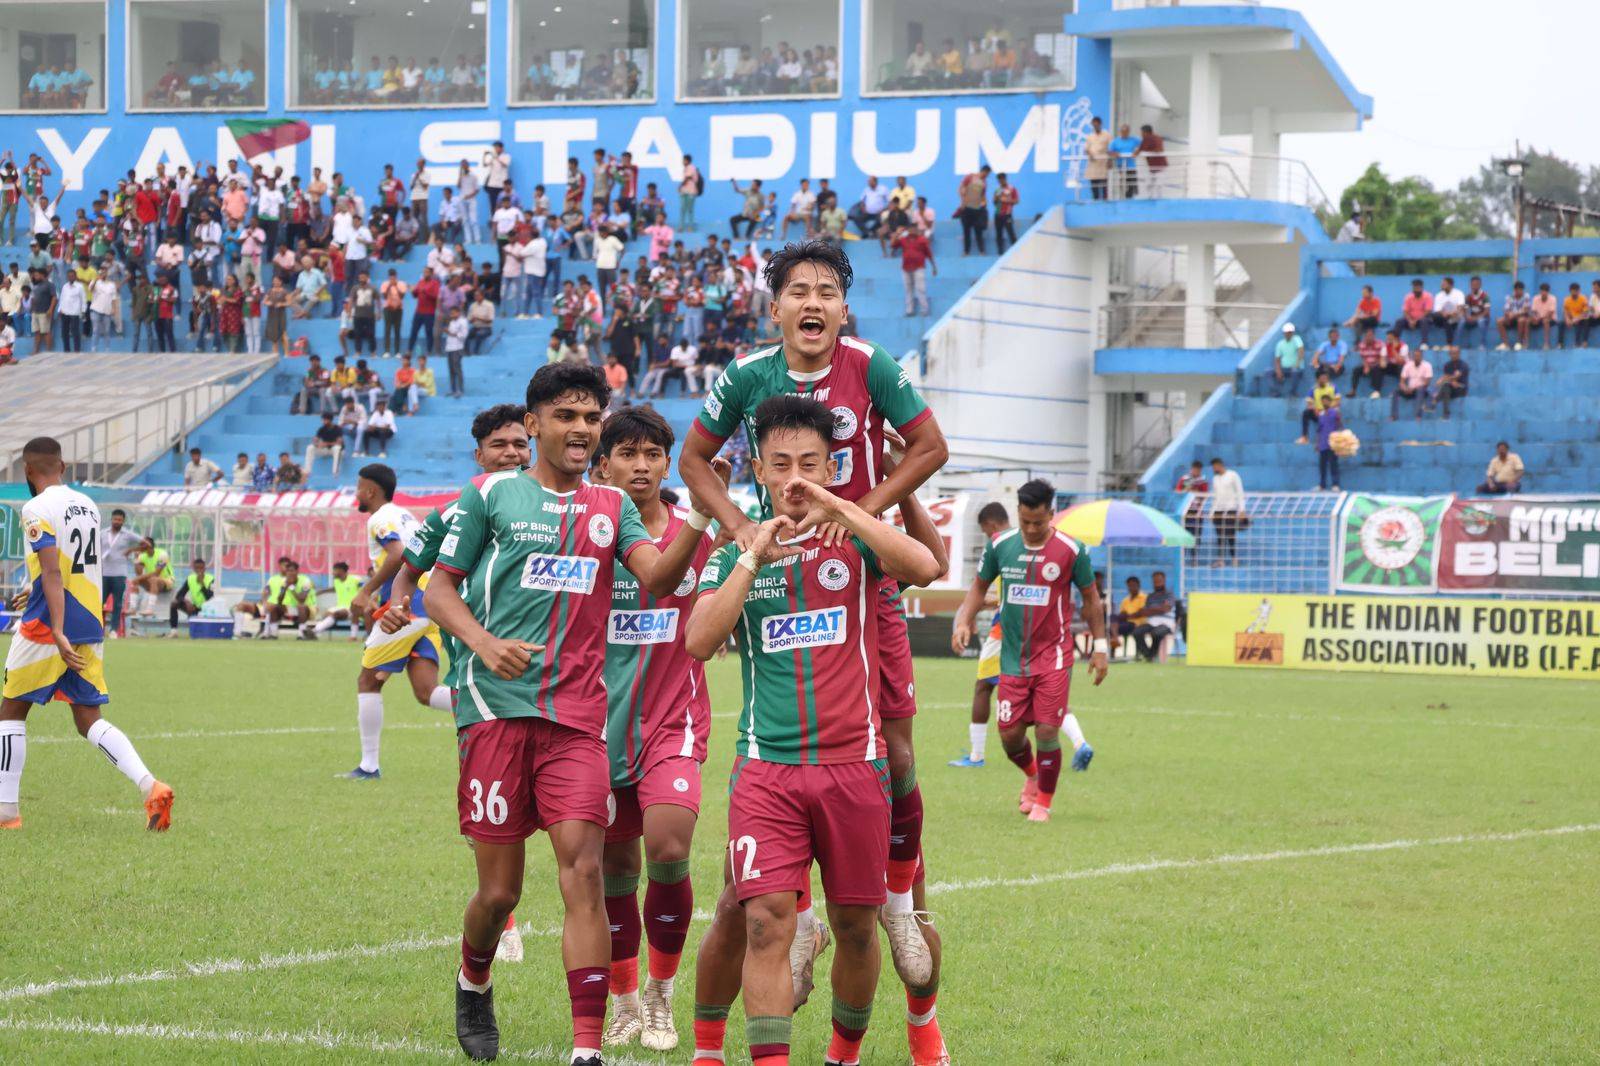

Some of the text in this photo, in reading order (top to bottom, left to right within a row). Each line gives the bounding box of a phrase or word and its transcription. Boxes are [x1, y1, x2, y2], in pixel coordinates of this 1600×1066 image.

[419, 103, 1061, 186] STADIUM
[511, 522, 560, 534] MP BIRLA
[513, 533, 556, 543] CEMENT
[1509, 506, 1600, 543] MOH
[70, 528, 97, 574] 24
[530, 557, 596, 580] 1XBAT
[754, 577, 788, 588] BIRLA
[745, 588, 786, 602] EMENT
[1012, 586, 1048, 599] 1XBAT
[613, 611, 676, 632] 1XBAT
[766, 609, 843, 640] 1XBAT
[1306, 602, 1600, 637] THE INDIAN FOOTBAL
[1302, 638, 1476, 671] ASSOCIATION,
[1488, 644, 1530, 669] WB
[469, 778, 508, 826] 36
[729, 835, 762, 886] 12
